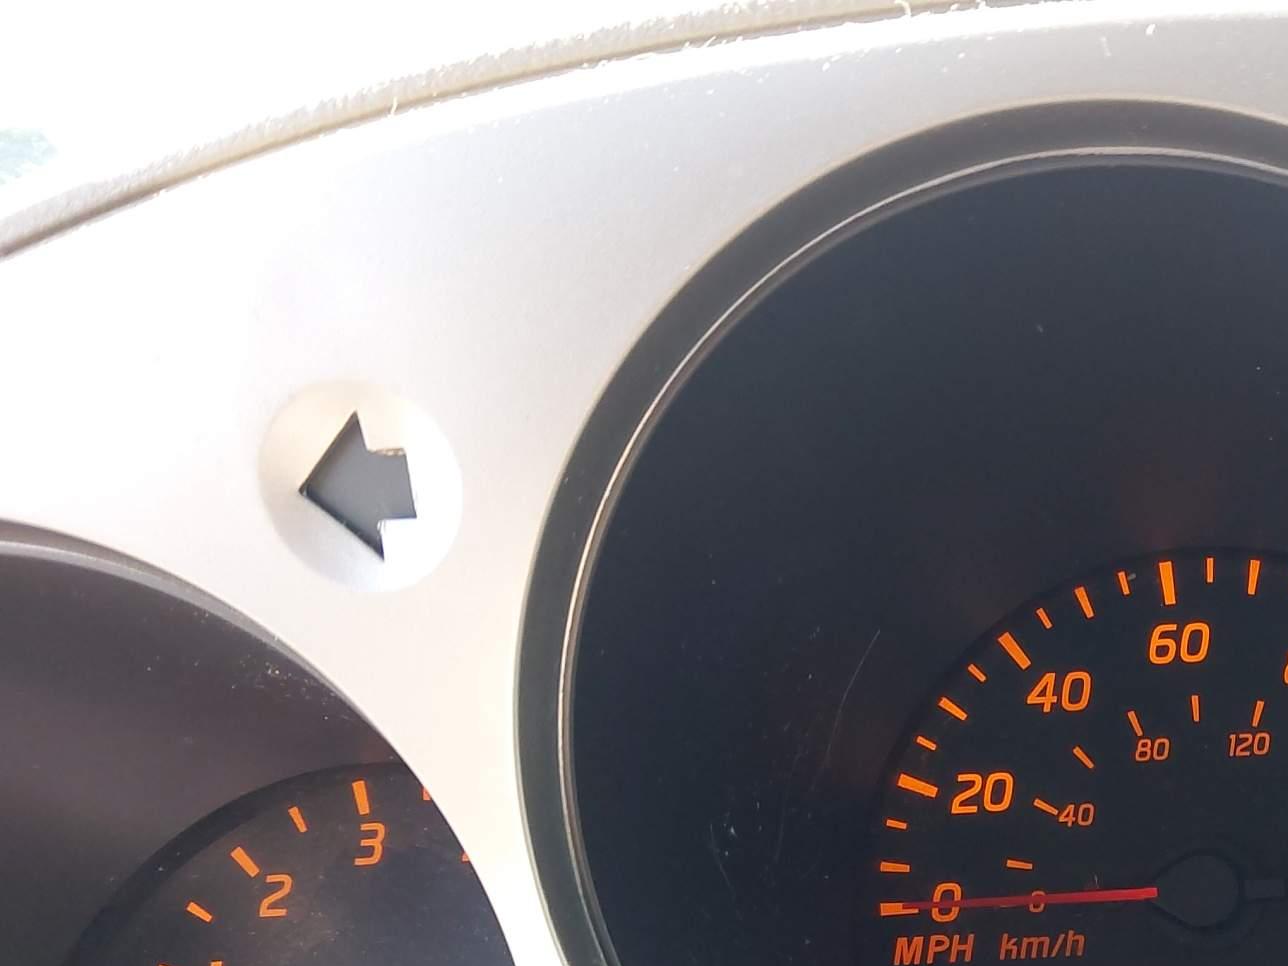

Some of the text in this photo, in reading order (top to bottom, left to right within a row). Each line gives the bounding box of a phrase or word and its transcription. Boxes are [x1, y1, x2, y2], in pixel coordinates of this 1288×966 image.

[1147, 620, 1211, 665] 60
[1026, 671, 1092, 713] 40
[1134, 737, 1171, 762] 80
[1228, 731, 1271, 757] 120
[950, 771, 1014, 815] 20
[1058, 802, 1095, 827] 40
[355, 821, 387, 866] 3
[258, 873, 294, 918] 2
[931, 882, 962, 922] 0
[893, 929, 1086, 966] MPH km/h
